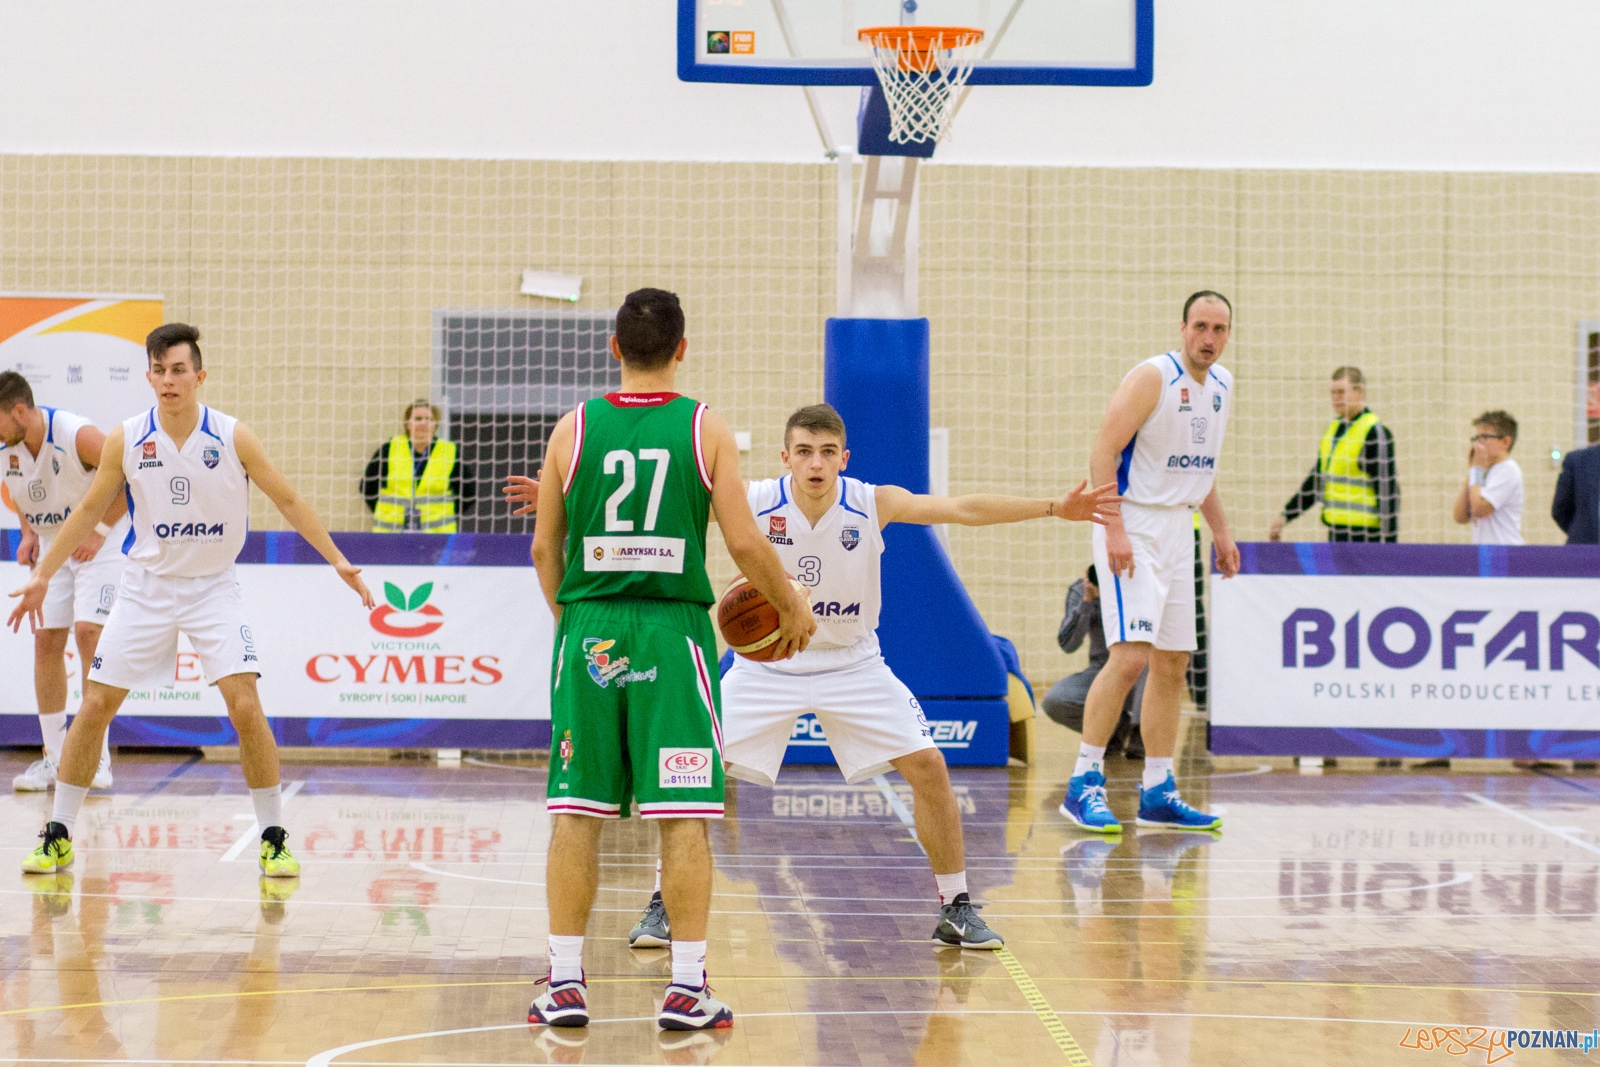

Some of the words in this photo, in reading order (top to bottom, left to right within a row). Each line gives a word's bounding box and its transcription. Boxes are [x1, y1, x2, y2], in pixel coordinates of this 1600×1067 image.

[1191, 417, 1207, 444] 12
[28, 479, 47, 502] 6
[170, 476, 190, 506] 9
[603, 448, 671, 532] 27
[659, 548, 675, 558] S.A.
[797, 556, 821, 587] 3
[99, 584, 115, 608] 6
[371, 641, 441, 651] VICTORIA
[305, 653, 503, 685] CYMES
[159, 691, 202, 701] NAPOJE
[339, 692, 383, 703] SYROPY
[391, 693, 417, 703] SOKI
[425, 693, 468, 704] NAPOJE
[1313, 682, 1396, 698] POLSKI
[1412, 683, 1553, 700] PRODUCENT
[675, 756, 699, 766] ELE
[671, 775, 707, 784] 8111111
